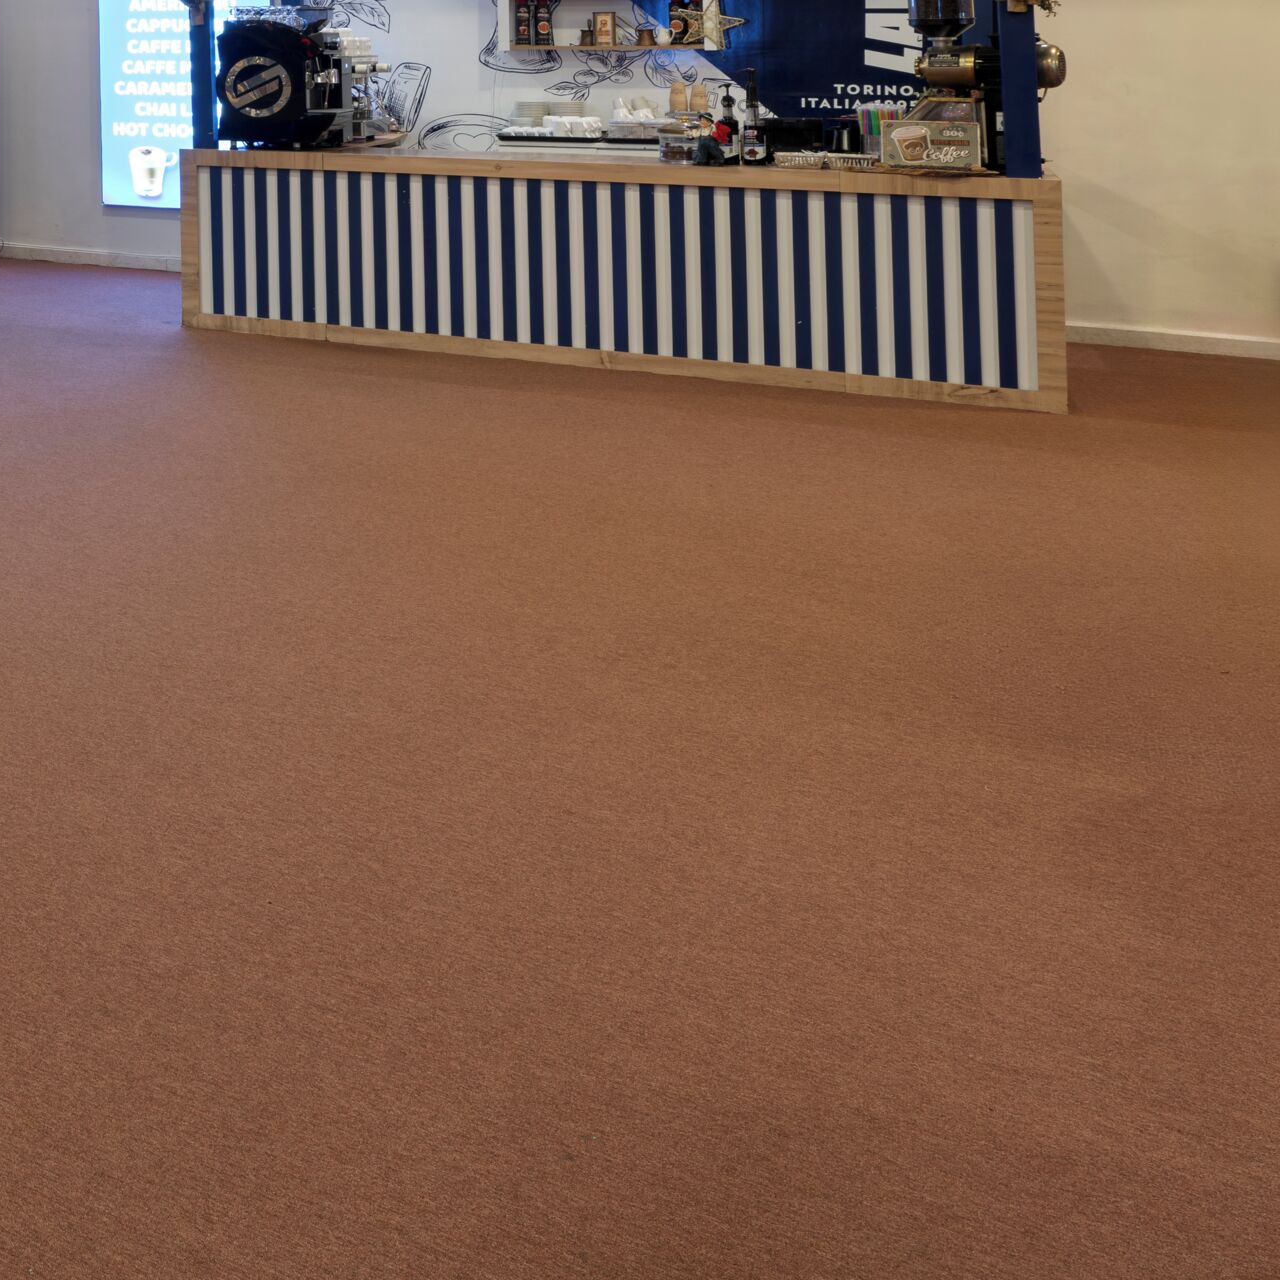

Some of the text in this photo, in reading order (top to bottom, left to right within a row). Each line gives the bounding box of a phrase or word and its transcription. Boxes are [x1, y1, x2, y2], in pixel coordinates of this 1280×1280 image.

[127, 39, 182, 54] CAFFE
[122, 60, 177, 74] CAFFE
[833, 84, 920, 98] TORINO,
[134, 102, 177, 116] CHAI
[112, 122, 149, 137] HOT
[922, 146, 970, 163] Coffee
